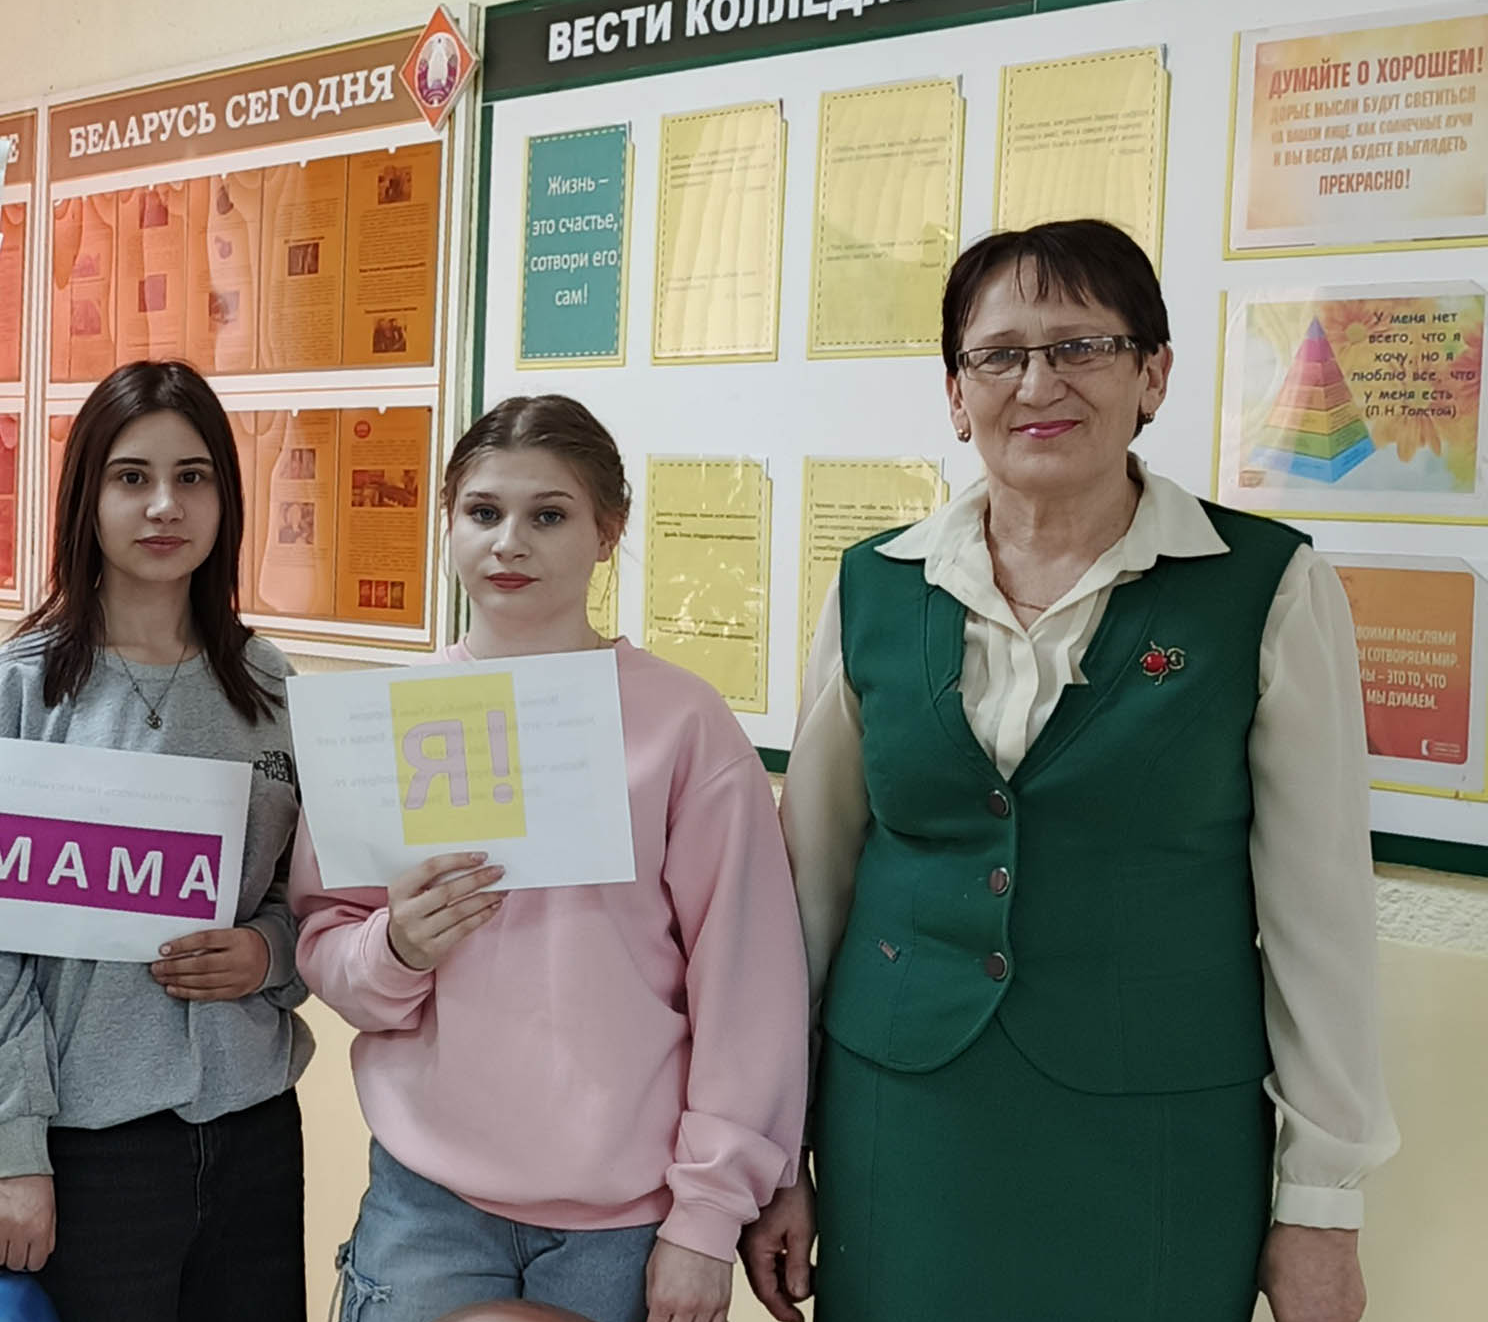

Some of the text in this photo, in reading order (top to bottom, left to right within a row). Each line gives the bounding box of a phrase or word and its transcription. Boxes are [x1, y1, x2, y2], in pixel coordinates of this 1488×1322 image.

[547, 0, 673, 63] ВЕСТИ
[1268, 46, 1485, 100] ДУМАЙТЕ О ХОРОШЕМ!
[1362, 93, 1401, 115] БУДУТ
[1405, 85, 1477, 109] СВЕТИТЬСЯ
[68, 101, 217, 159] БЕЛАРУСЬ
[224, 64, 396, 129] СЕГОДНЯ
[1305, 144, 1348, 165] ВСЕГДА
[1351, 141, 1394, 161] БУДЕТЕ
[1397, 134, 1468, 157] ВЫГЛЯДЕТЬ
[546, 175, 596, 196] Жизнь
[1318, 168, 1411, 196] ПРЕКРАСНО!
[531, 212, 619, 237] это счастье,
[530, 252, 589, 274] сотвори
[554, 283, 589, 307] сам!
[1373, 311, 1458, 325] У меня нет
[1368, 332, 1461, 345] всего, что я
[1373, 351, 1413, 366] хочу,
[1421, 351, 1440, 362] но
[1351, 368, 1407, 382] люблю
[1450, 370, 1476, 380] что
[1378, 389, 1416, 400] меня
[1400, 404, 1457, 418] Толстой)
[1396, 627, 1457, 646] МЫСЛЯМИ
[1367, 646, 1431, 666] СОТВОРЯЕМ
[1386, 670, 1406, 686] ЭТО
[1425, 673, 1448, 689] ЧТО
[1366, 688, 1386, 704] МЫ
